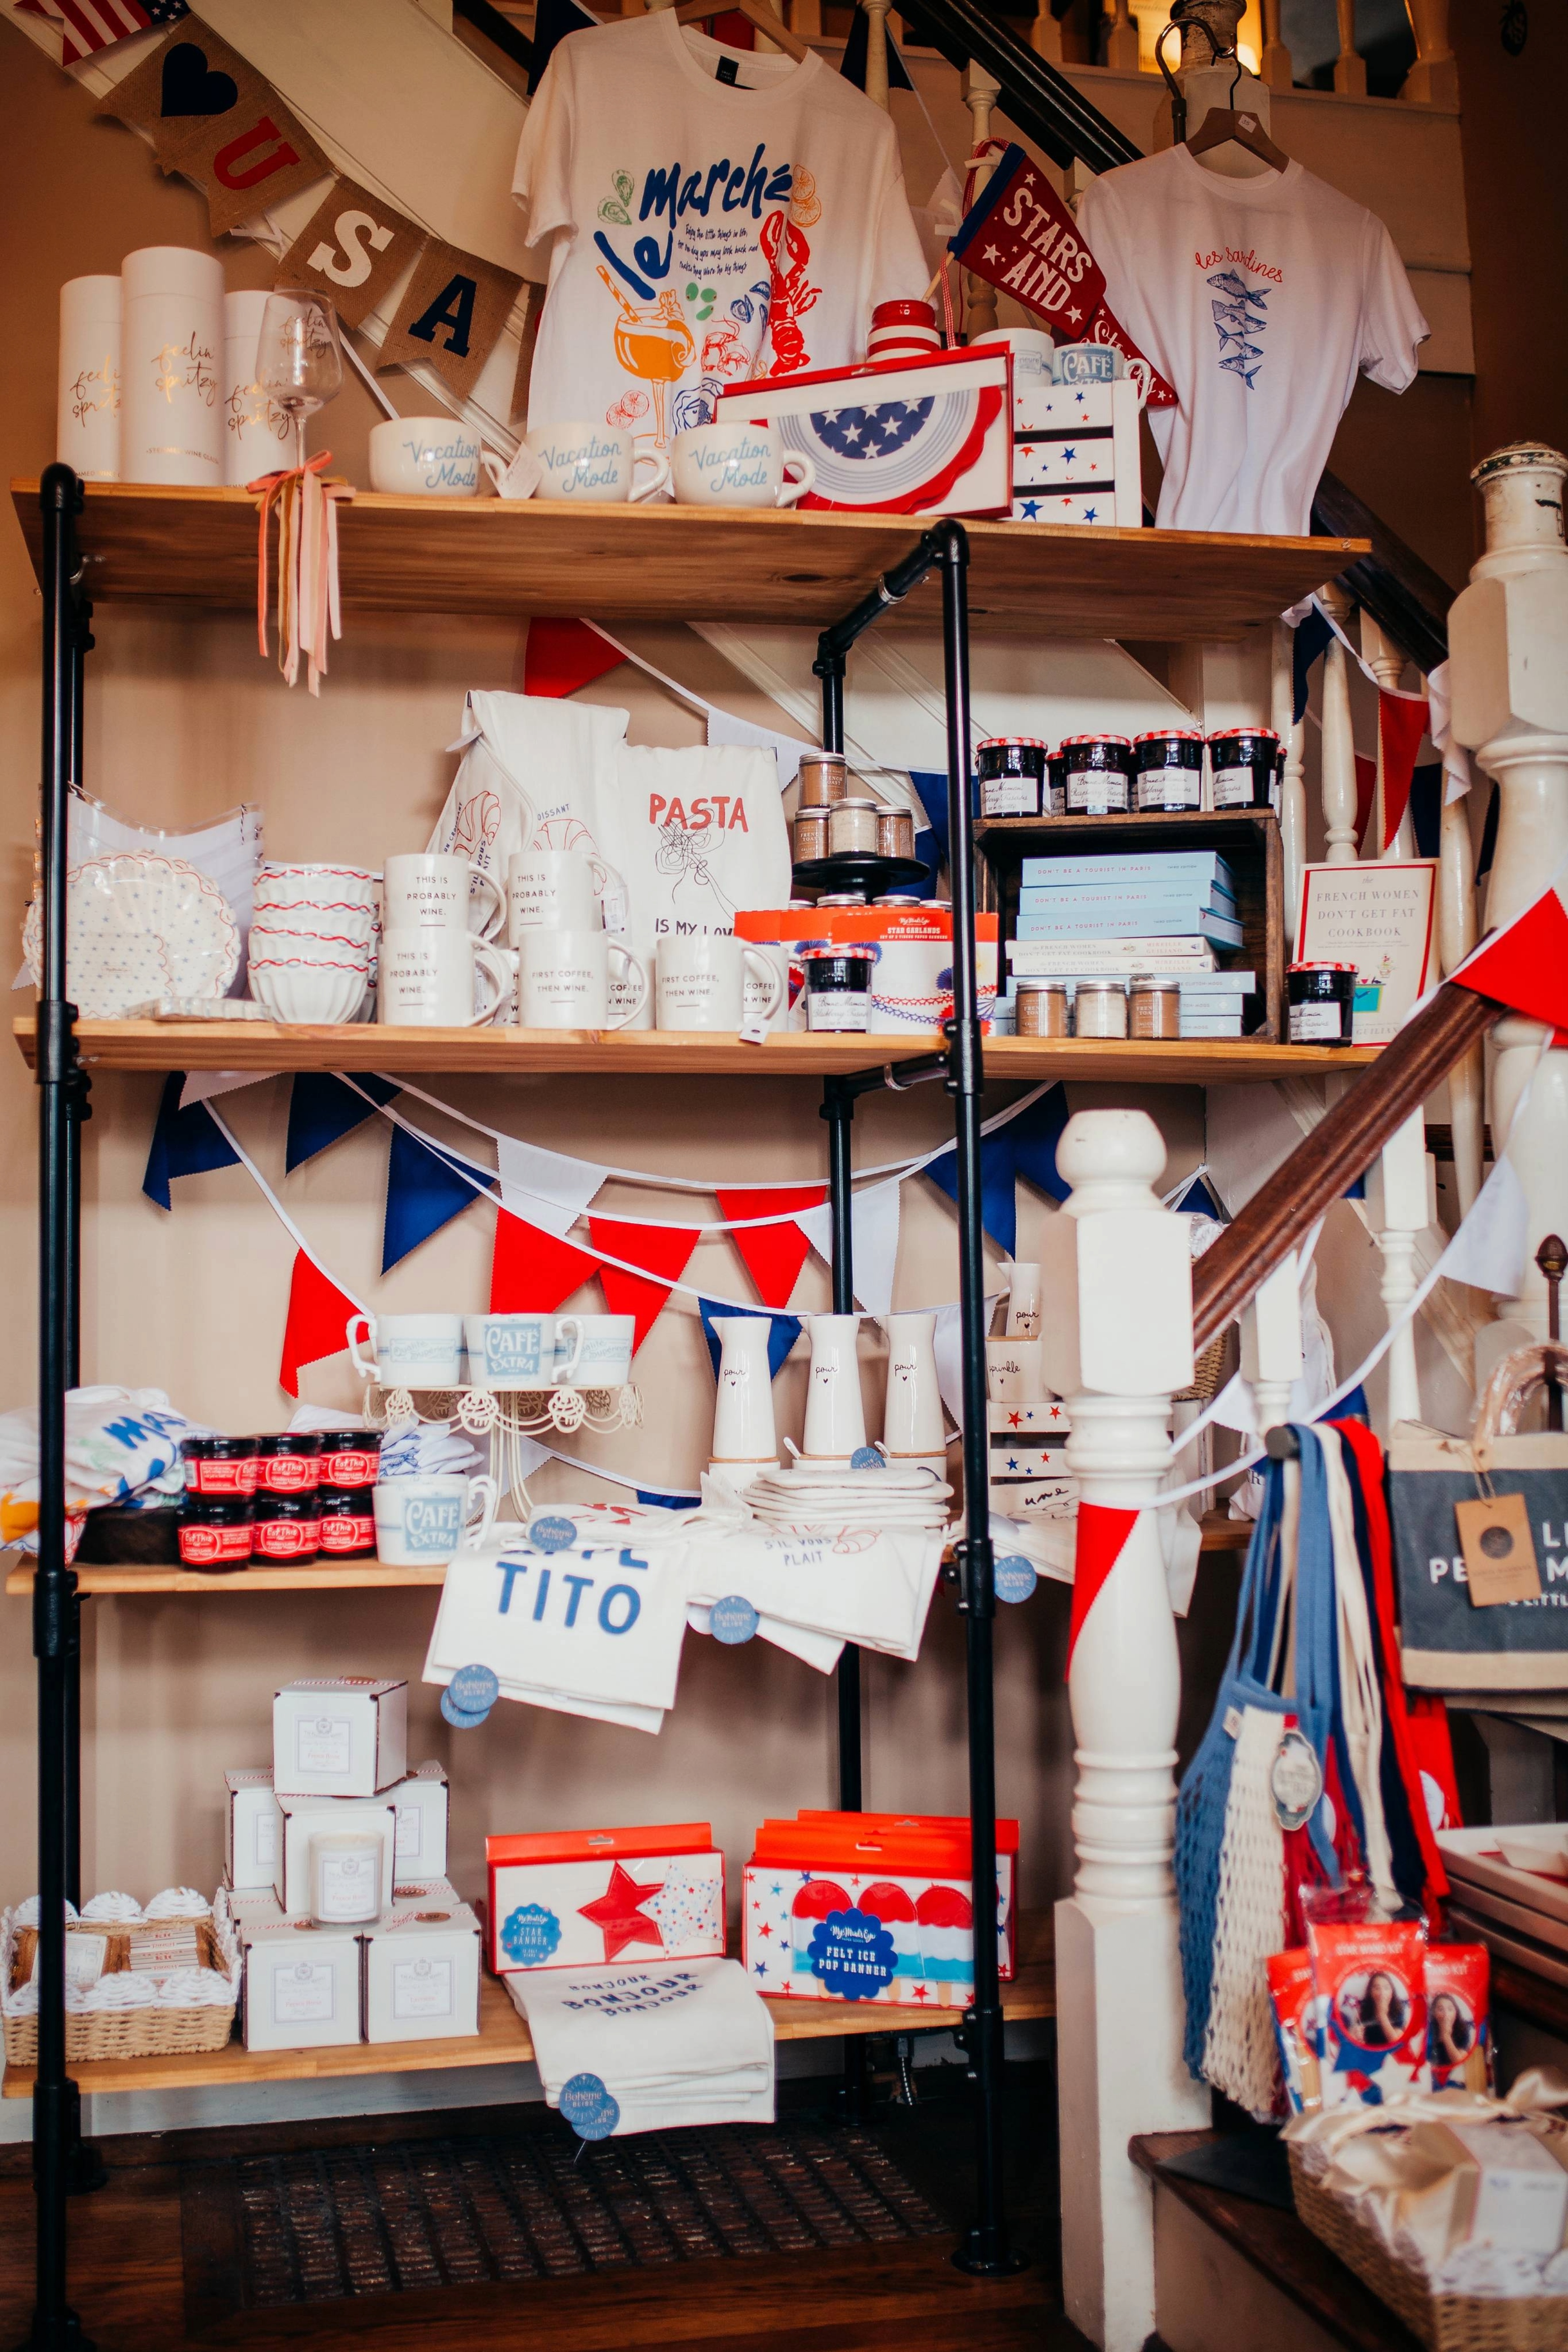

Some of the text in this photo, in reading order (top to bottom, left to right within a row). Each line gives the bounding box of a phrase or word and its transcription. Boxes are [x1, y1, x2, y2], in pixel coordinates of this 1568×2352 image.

[686, 223, 696, 240] Enjoy
[705, 229, 716, 240] little
[717, 227, 731, 241] things
[1003, 187, 1092, 282] STARS
[700, 250, 708, 261] you
[710, 249, 721, 260] may
[723, 245, 732, 256] look
[735, 243, 746, 253] back
[748, 243, 759, 252] and
[733, 261, 747, 274] things
[1226, 247, 1283, 283] sardines
[1001, 250, 1071, 311] AND
[1064, 353, 1112, 382] CAFÉ
[155, 361, 217, 407] spritzy
[228, 399, 292, 440] spritzy
[403, 435, 479, 463] Vacation
[538, 435, 622, 470] Vacation
[693, 436, 771, 470] Vacation
[426, 460, 476, 487] Mode
[563, 465, 618, 492] Mode
[710, 465, 767, 492] Mode
[537, 804, 569, 821] OISSANT
[649, 793, 749, 833] PASTA
[444, 843, 450, 852] UN
[476, 840, 486, 866] VOUS
[518, 875, 534, 883] THIS
[1362, 876, 1373, 884] the
[512, 890, 556, 899] PROBABLY
[1317, 890, 1419, 902] FRENCH WOMEN
[1318, 908, 1416, 919] DON'T GET FAT
[656, 918, 669, 933] IS
[676, 920, 697, 936] MY
[1328, 927, 1402, 937] COOKBOOK
[390, 969, 438, 978] PROBABLY
[558, 970, 593, 980] COFFEE,
[564, 984, 589, 992] WINE.
[1016, 1311, 1040, 1322] pour
[486, 1326, 539, 1359] CAFÉ
[491, 1356, 534, 1372] EXTRA
[894, 1362, 918, 1379] pour
[724, 1368, 747, 1382] pour
[815, 1365, 838, 1381] pour
[272, 1461, 302, 1472] Eat This
[335, 1458, 364, 1468] Eat This
[267, 1527, 297, 1537] Eat This
[322, 1522, 350, 1532] Eat This
[185, 1533, 212, 1542] Eat This
[410, 1531, 454, 1547] EXTRA
[765, 1538, 832, 1550] S'IL VOUS
[784, 1551, 822, 1566] PLAIT
[496, 1561, 641, 1635] TITO
[520, 1927, 542, 1937] STAR
[831, 1925, 842, 1940] My
[863, 1929, 876, 1943] Eye
[514, 1936, 547, 1946] BANNER
[827, 1946, 875, 1962] FELT ICE
[819, 1958, 886, 1977] POP BANNER
[569, 1974, 651, 1991] BONJOUR
[562, 1973, 699, 2010] BONJOUR
[601, 1984, 703, 2017] BONJOUR
